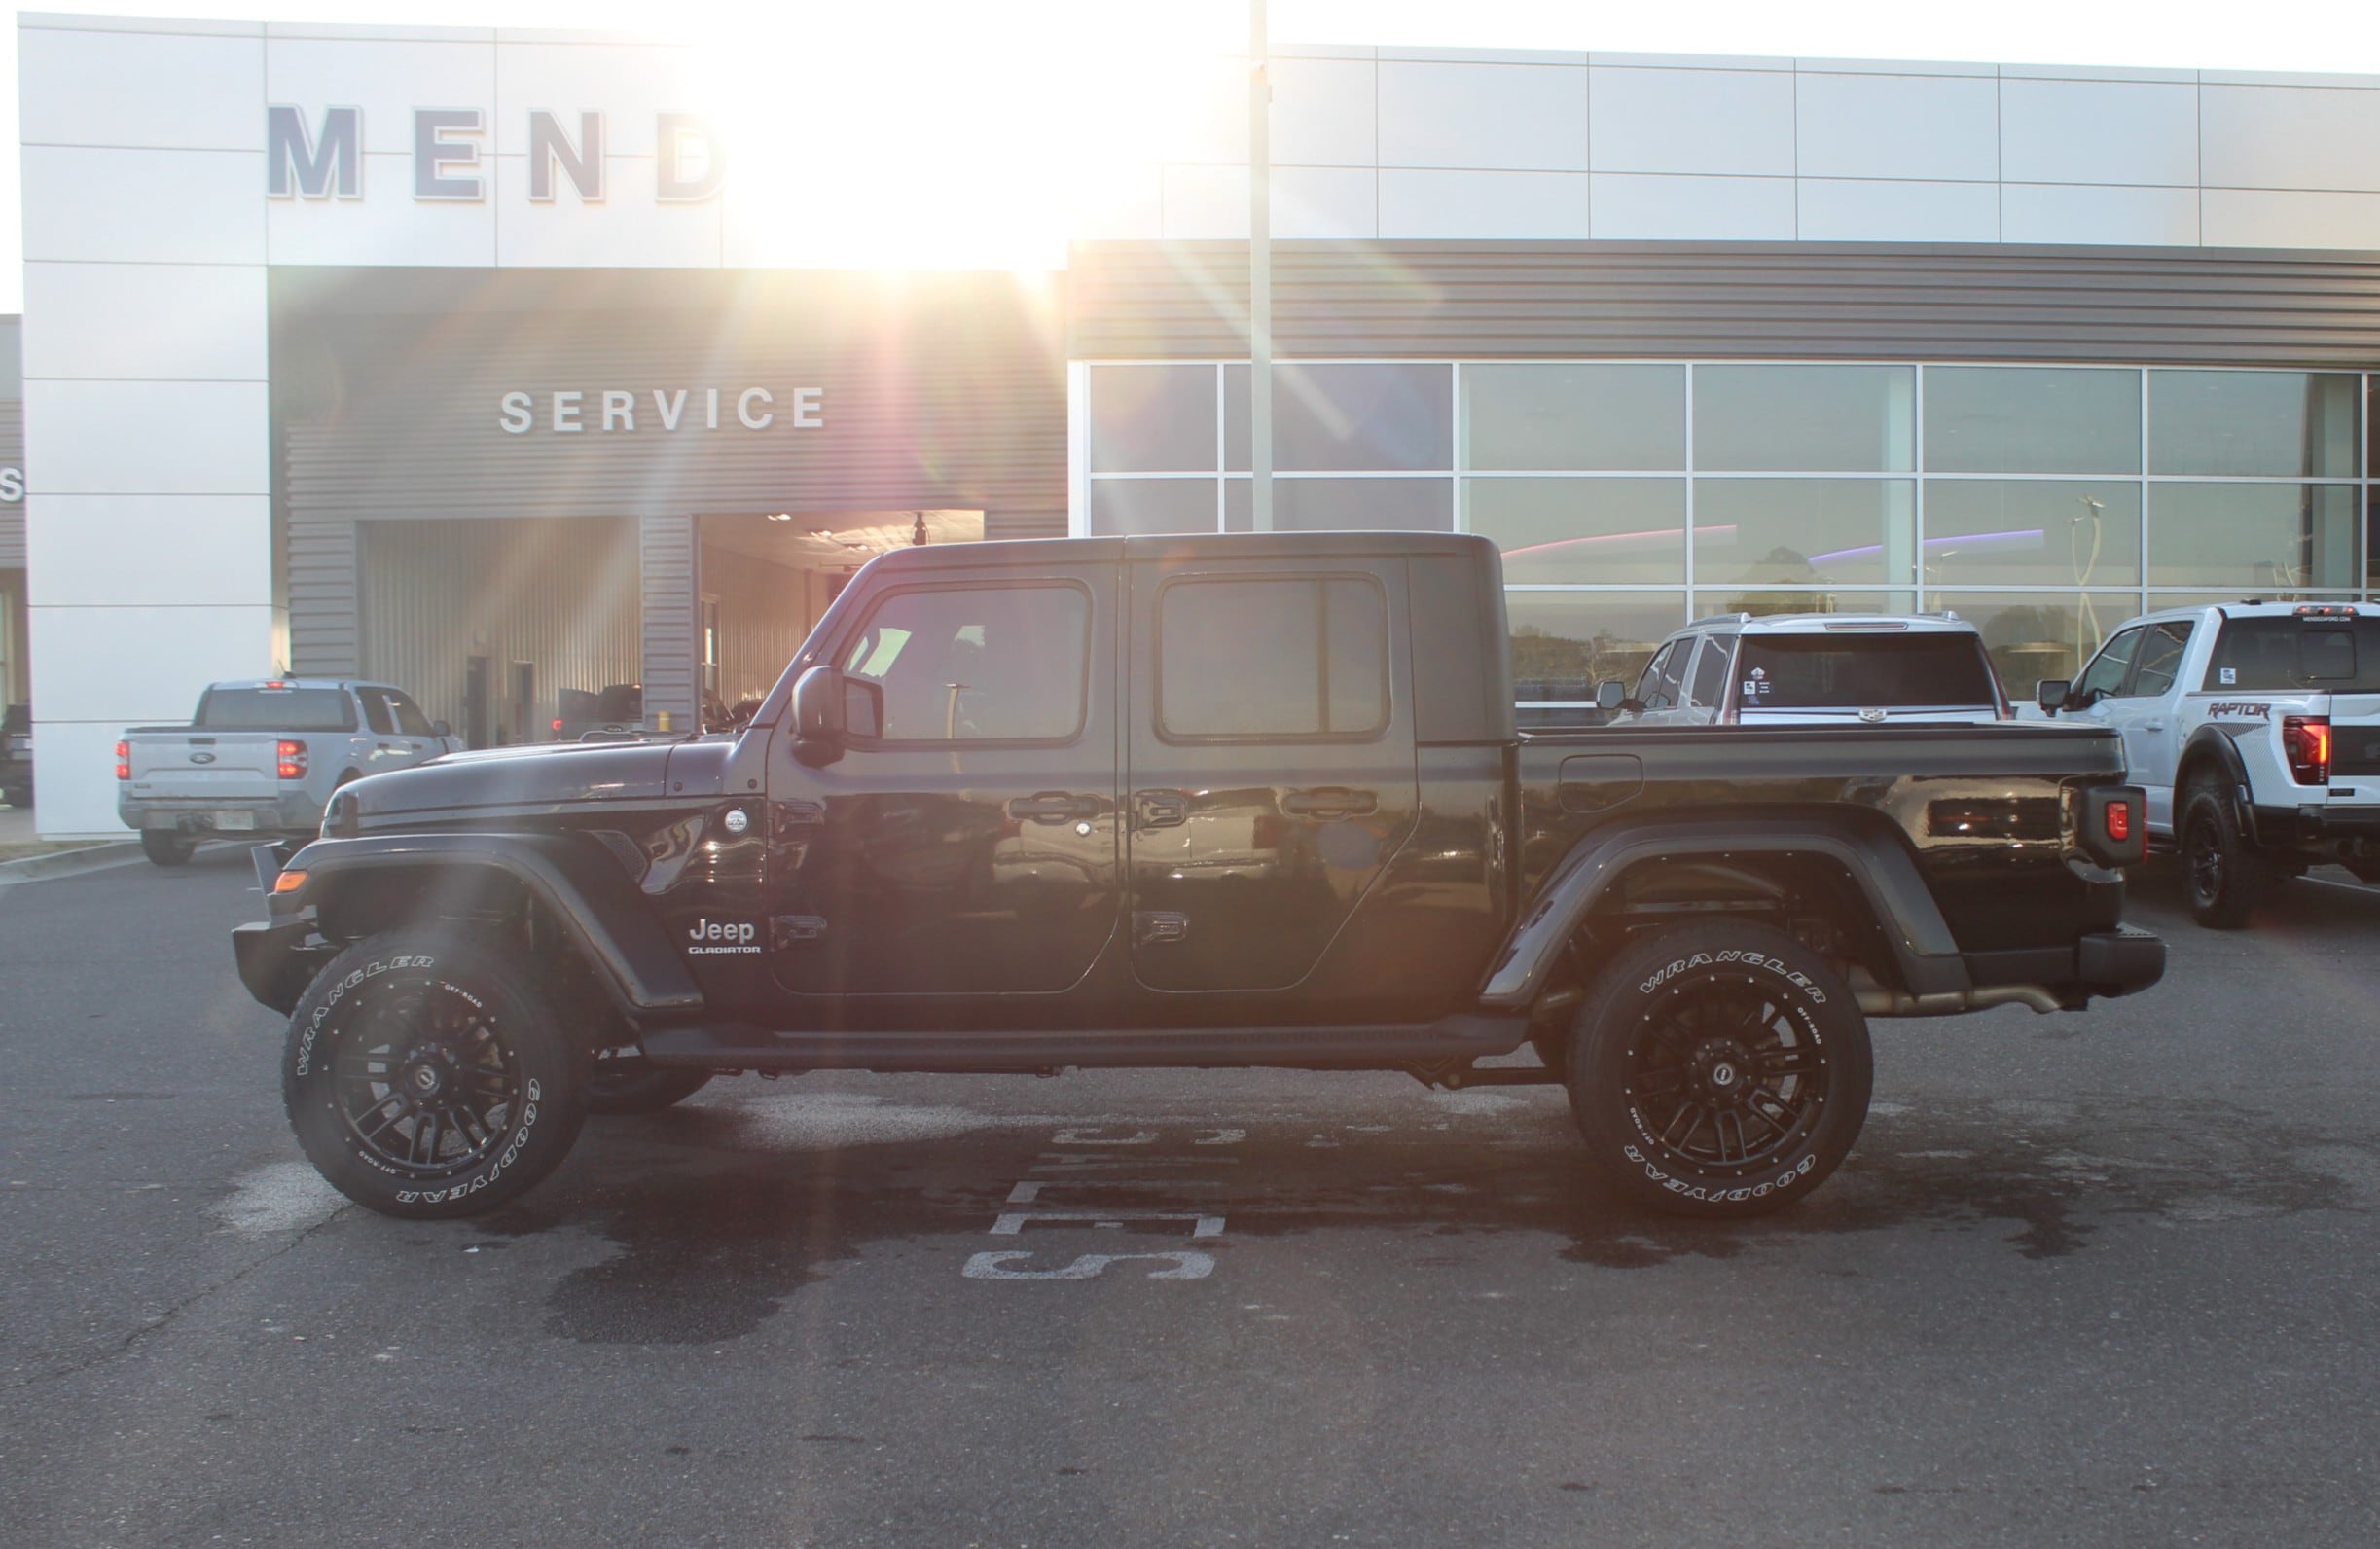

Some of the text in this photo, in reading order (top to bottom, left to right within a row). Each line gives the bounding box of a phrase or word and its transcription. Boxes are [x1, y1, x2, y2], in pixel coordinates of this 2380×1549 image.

[499, 387, 824, 434] SERVICE
[2208, 702, 2272, 721] RAPTOR
[688, 946, 762, 955] GLADIATOR
[689, 918, 755, 945] Jeep
[1640, 950, 1827, 1004] WRANGLER
[297, 955, 434, 1076] WRANGLER
[1797, 1007, 1822, 1045] OFF-ROAD
[396, 1078, 540, 1203] GOODYEAR
[1624, 1144, 1816, 1203] GOODYEAR
